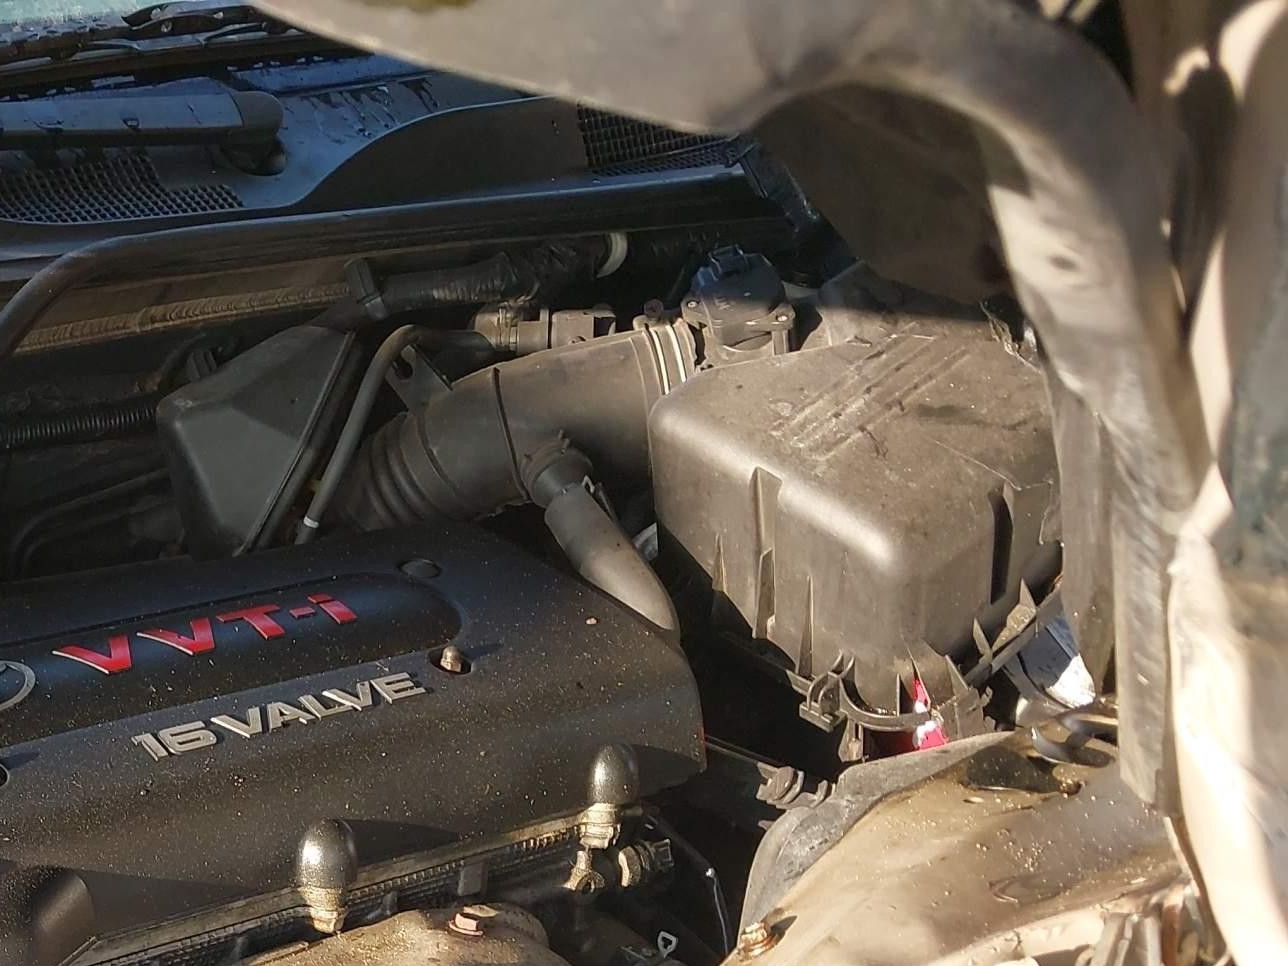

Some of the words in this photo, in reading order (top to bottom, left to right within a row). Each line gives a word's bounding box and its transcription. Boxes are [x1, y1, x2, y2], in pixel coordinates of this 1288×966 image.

[52, 593, 358, 675] VVT-i
[131, 720, 217, 762] 16
[210, 671, 426, 738] VALVE
